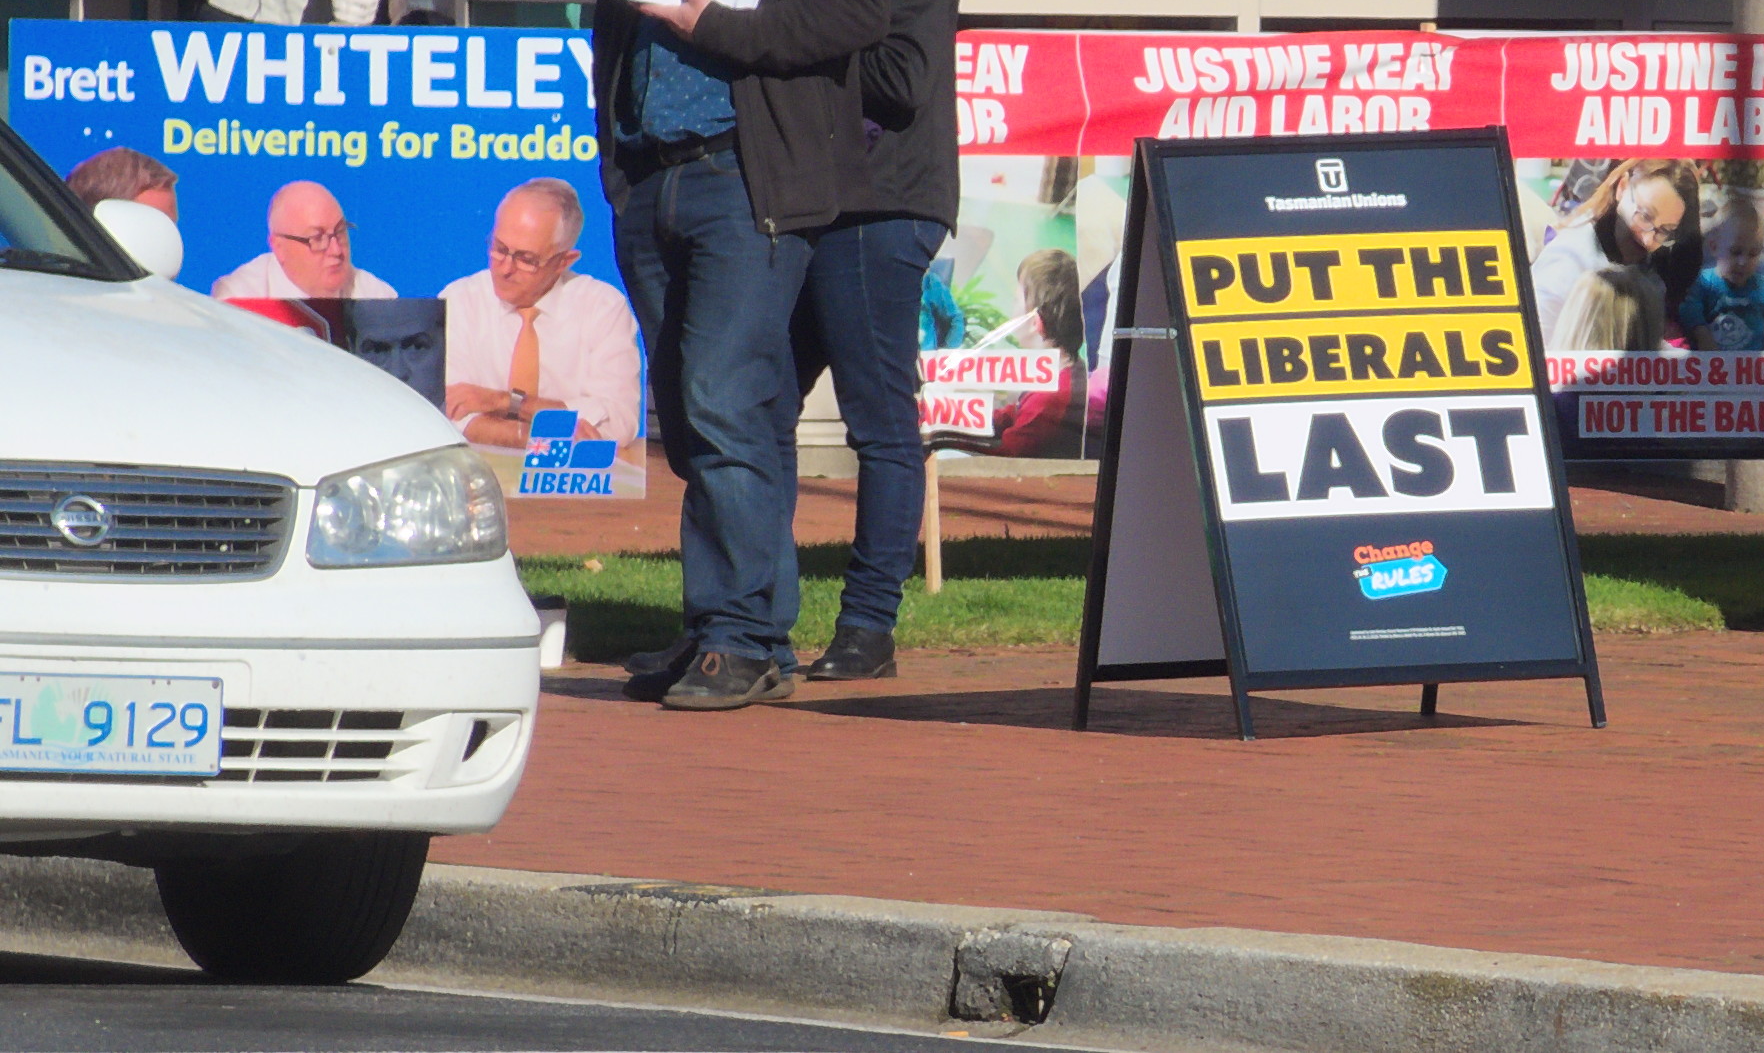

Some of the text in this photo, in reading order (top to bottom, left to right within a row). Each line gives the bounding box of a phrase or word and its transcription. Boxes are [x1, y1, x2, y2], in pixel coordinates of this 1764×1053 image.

[23, 55, 135, 102] Brett
[955, 42, 1029, 95] EAY
[1134, 42, 1456, 94] JUSTINE KEAY
[1550, 42, 1737, 92] JUSTINE
[1158, 95, 1432, 139] AND LABOR
[1575, 96, 1671, 146] AND
[163, 118, 599, 166] Delivering for Braddo
[1191, 246, 1505, 305] PUT THE
[920, 356, 1053, 384] OSPITALS
[1202, 329, 1519, 388] LIBERALS
[1548, 357, 1577, 385] OR
[1584, 357, 1701, 385] SCHOOLS
[1708, 358, 1729, 385] &
[918, 397, 986, 429] ANKS
[1585, 401, 1643, 433] NOT
[1650, 401, 1706, 433] THE
[1218, 408, 1529, 504] LAST
[518, 471, 613, 495] LIBERAL
[1354, 540, 1434, 564] Change
[1371, 563, 1435, 590] RULES
[84, 700, 208, 748] 9129
[98, 751, 152, 764] NATURAL
[158, 754, 197, 764] STATE
